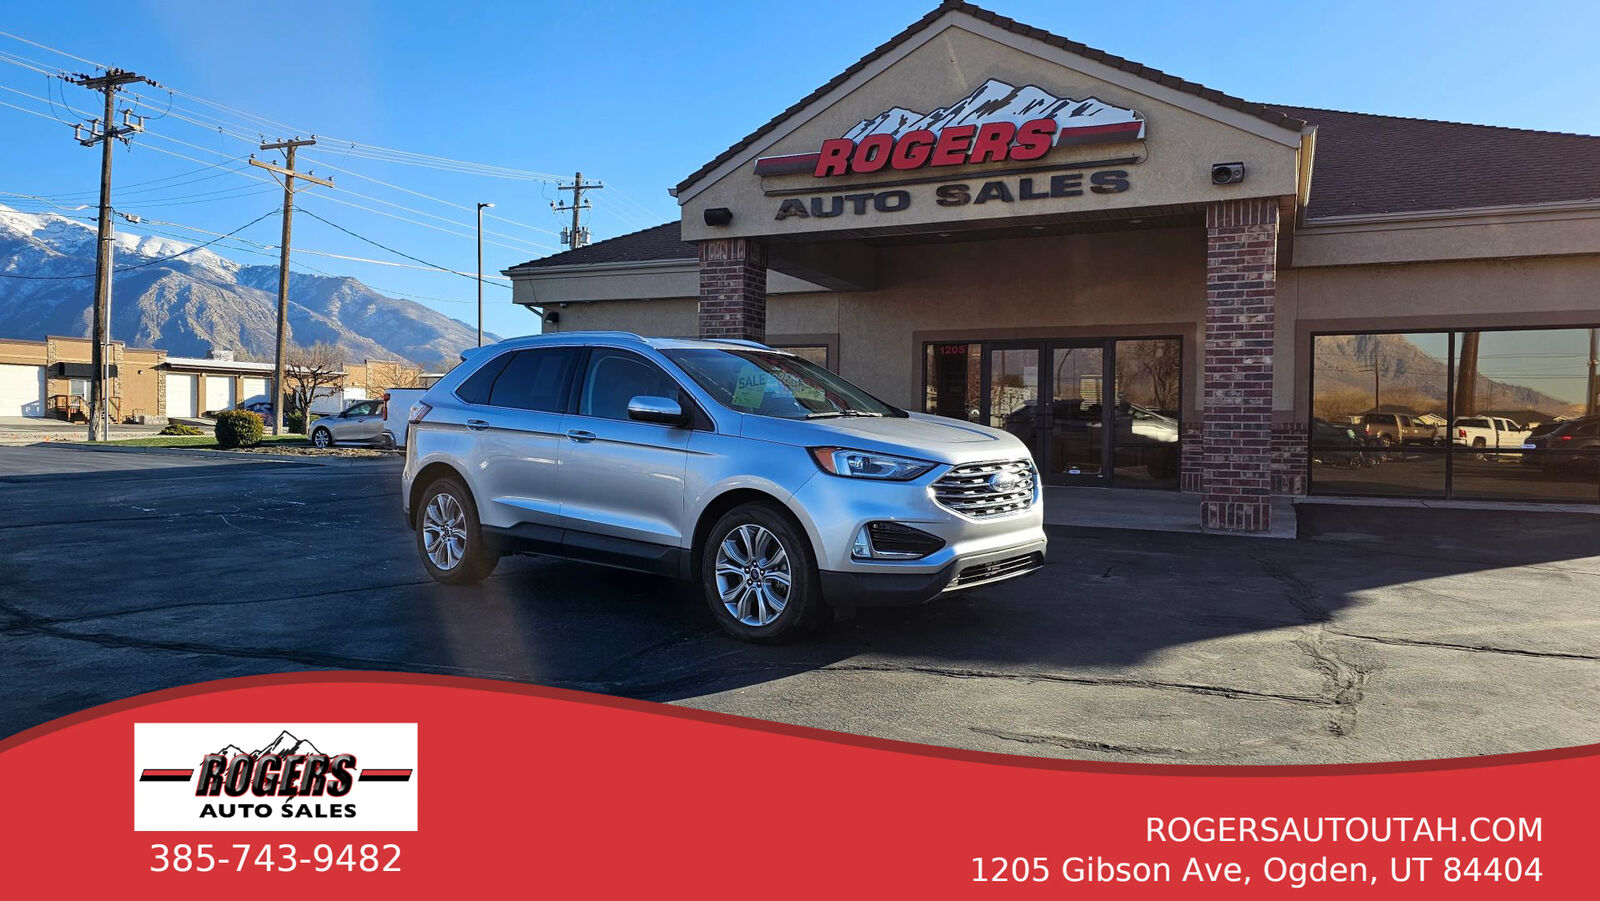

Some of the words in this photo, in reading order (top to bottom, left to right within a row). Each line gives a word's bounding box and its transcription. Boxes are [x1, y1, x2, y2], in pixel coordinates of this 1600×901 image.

[813, 118, 1057, 179] ROGERS
[775, 190, 911, 221] AUTO
[936, 170, 1130, 207] SALES
[940, 345, 966, 356] 1205
[738, 375, 767, 390] SALE
